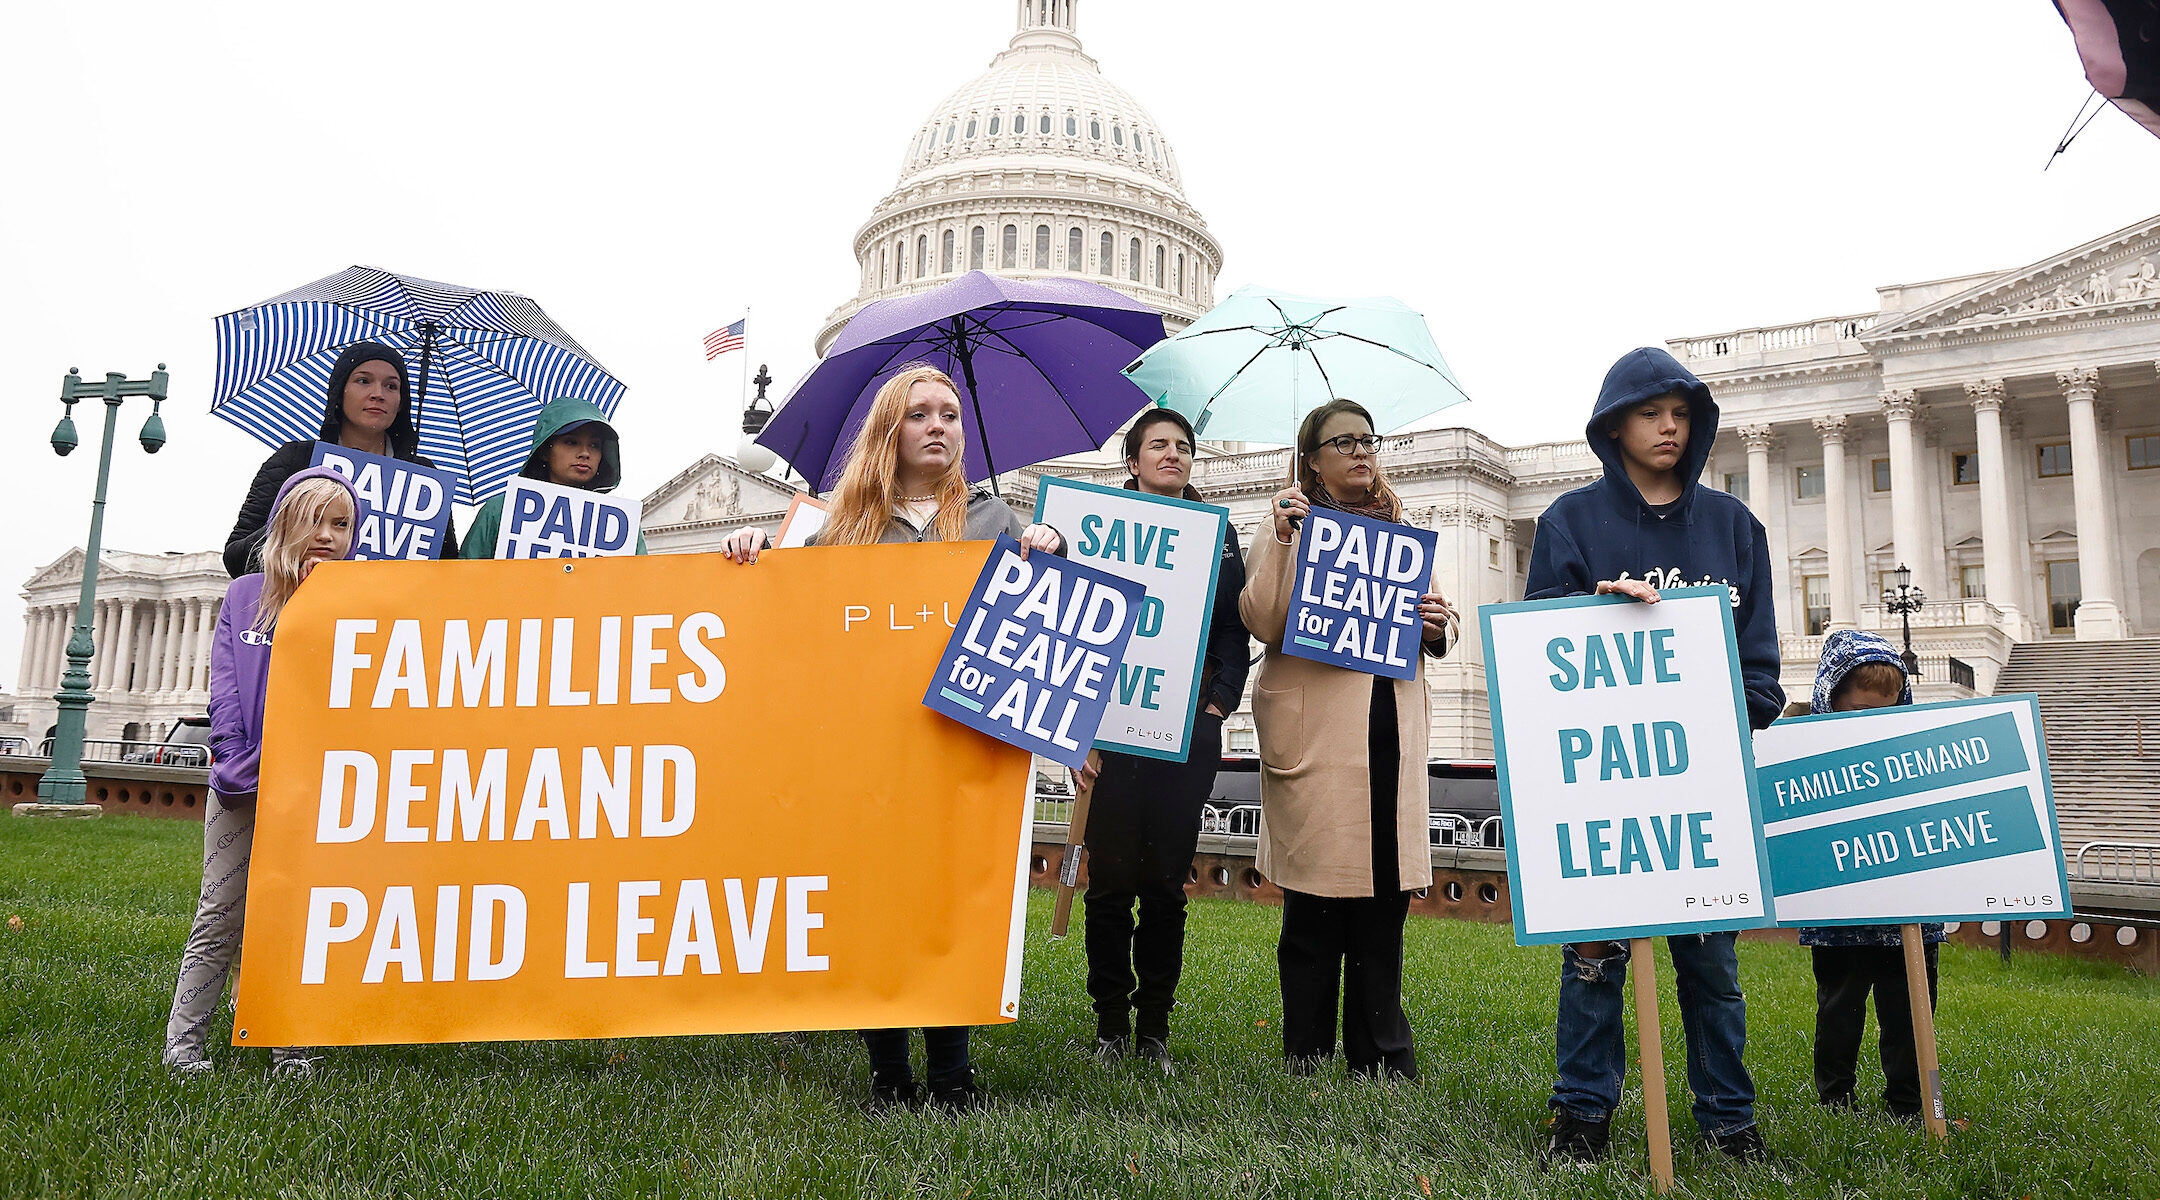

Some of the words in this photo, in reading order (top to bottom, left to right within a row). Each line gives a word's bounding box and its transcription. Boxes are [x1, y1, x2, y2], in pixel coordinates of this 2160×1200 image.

[510, 487, 629, 551] PAID
[1077, 514, 1180, 571] SAVE
[1306, 516, 1424, 584] PAID
[981, 549, 1128, 646] PAID
[1300, 566, 1418, 626] LEAVE
[328, 611, 727, 709] FAMILIES
[961, 606, 1111, 701] LEAVE
[1298, 607, 1334, 636] for
[1332, 617, 1408, 668] ALL
[1546, 628, 1681, 692] SAVE
[949, 654, 996, 696] for
[986, 677, 1080, 752] ALL
[1558, 721, 1689, 784] PAID
[1774, 760, 1880, 807] FAMILIES
[1886, 736, 1991, 783] DEMAND
[315, 744, 697, 844] DEMAND
[1555, 811, 1719, 879] LEAVE
[1831, 830, 1900, 872] PAID
[1905, 810, 1999, 858] LEAVE
[300, 884, 529, 985] PAID
[564, 875, 830, 979] LEAVE
